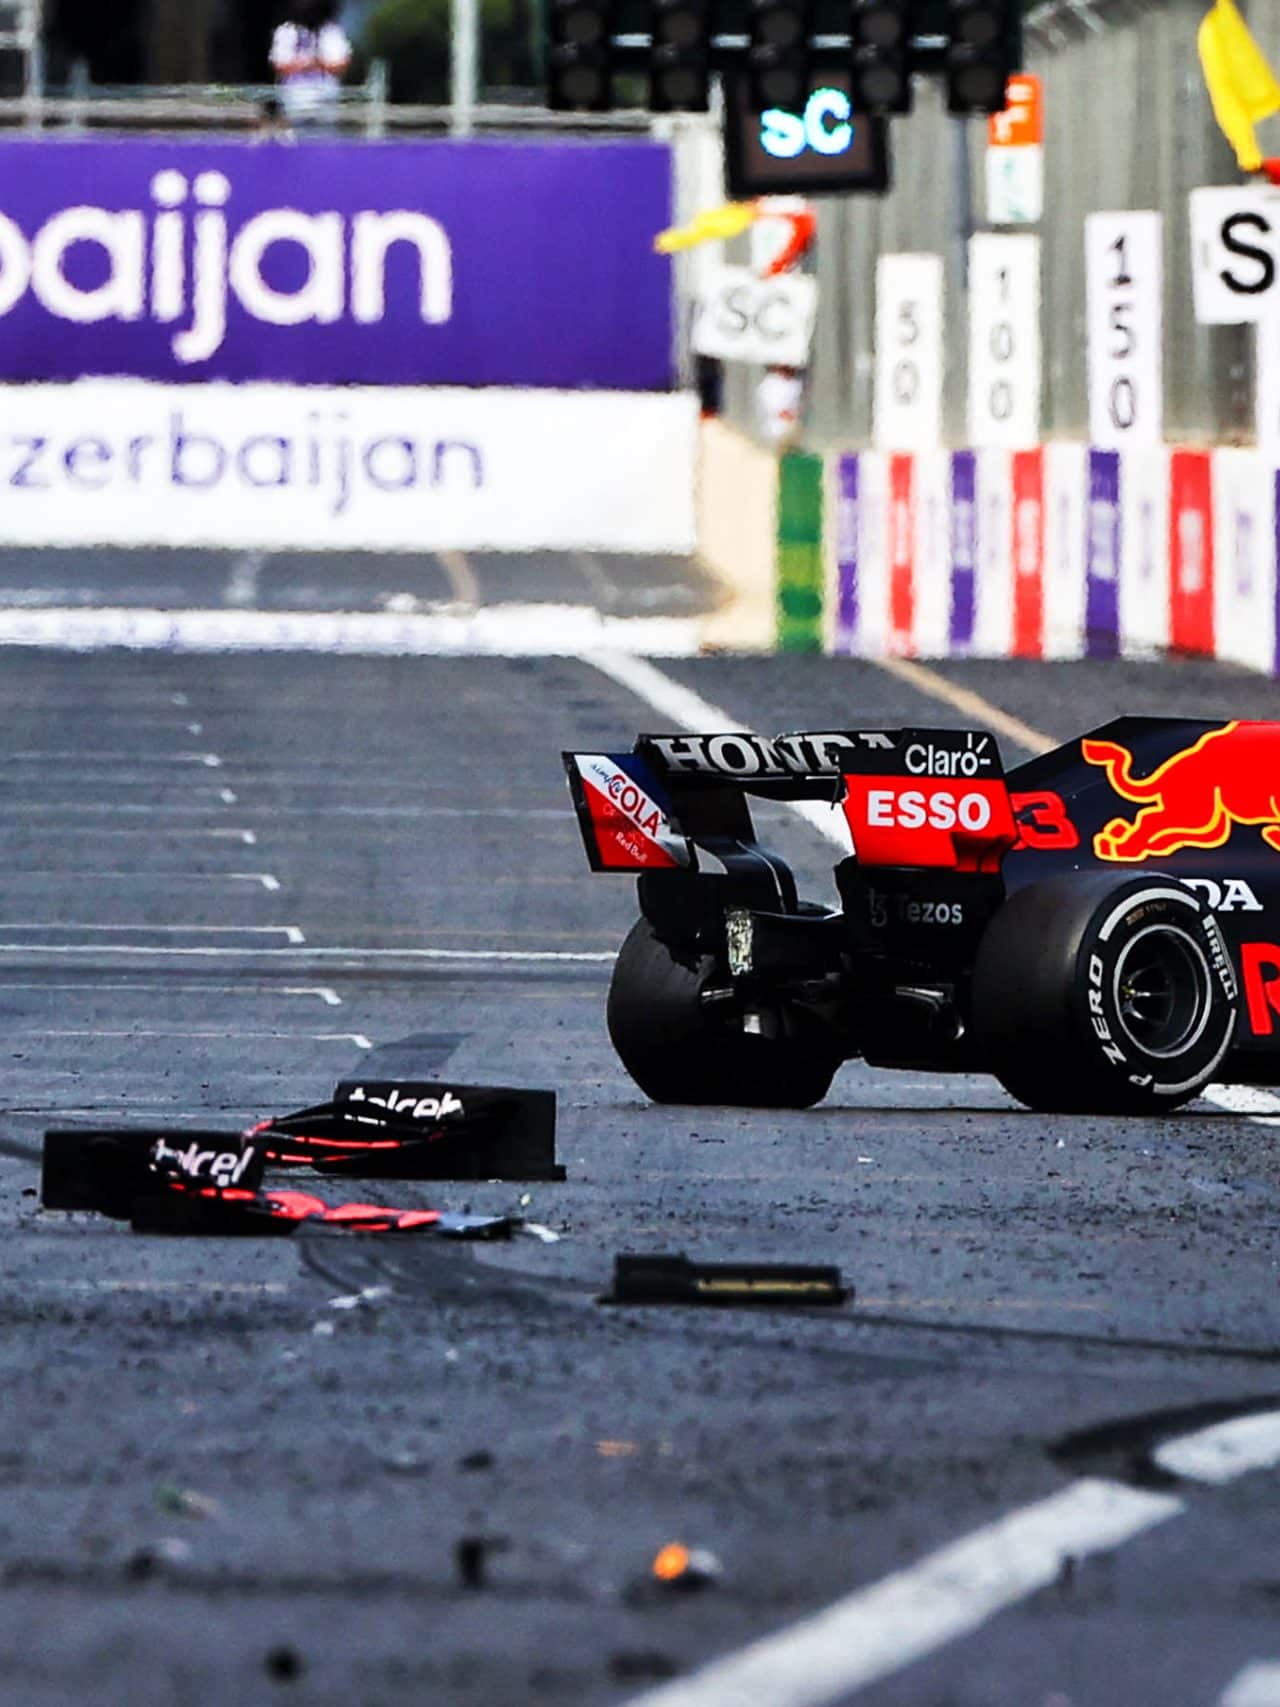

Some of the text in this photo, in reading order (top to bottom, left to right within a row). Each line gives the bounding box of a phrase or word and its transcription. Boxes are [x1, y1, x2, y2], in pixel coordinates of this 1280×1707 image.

[759, 87, 853, 158] SC
[718, 284, 792, 342] SC
[1107, 234, 1138, 430] 150
[8, 410, 485, 518] zerbaijan
[905, 742, 979, 776] Claro
[608, 774, 660, 838] COLA
[867, 790, 991, 831] ESSO
[1202, 913, 1239, 1001] PIRELLI
[1088, 953, 1127, 1065] ZERO
